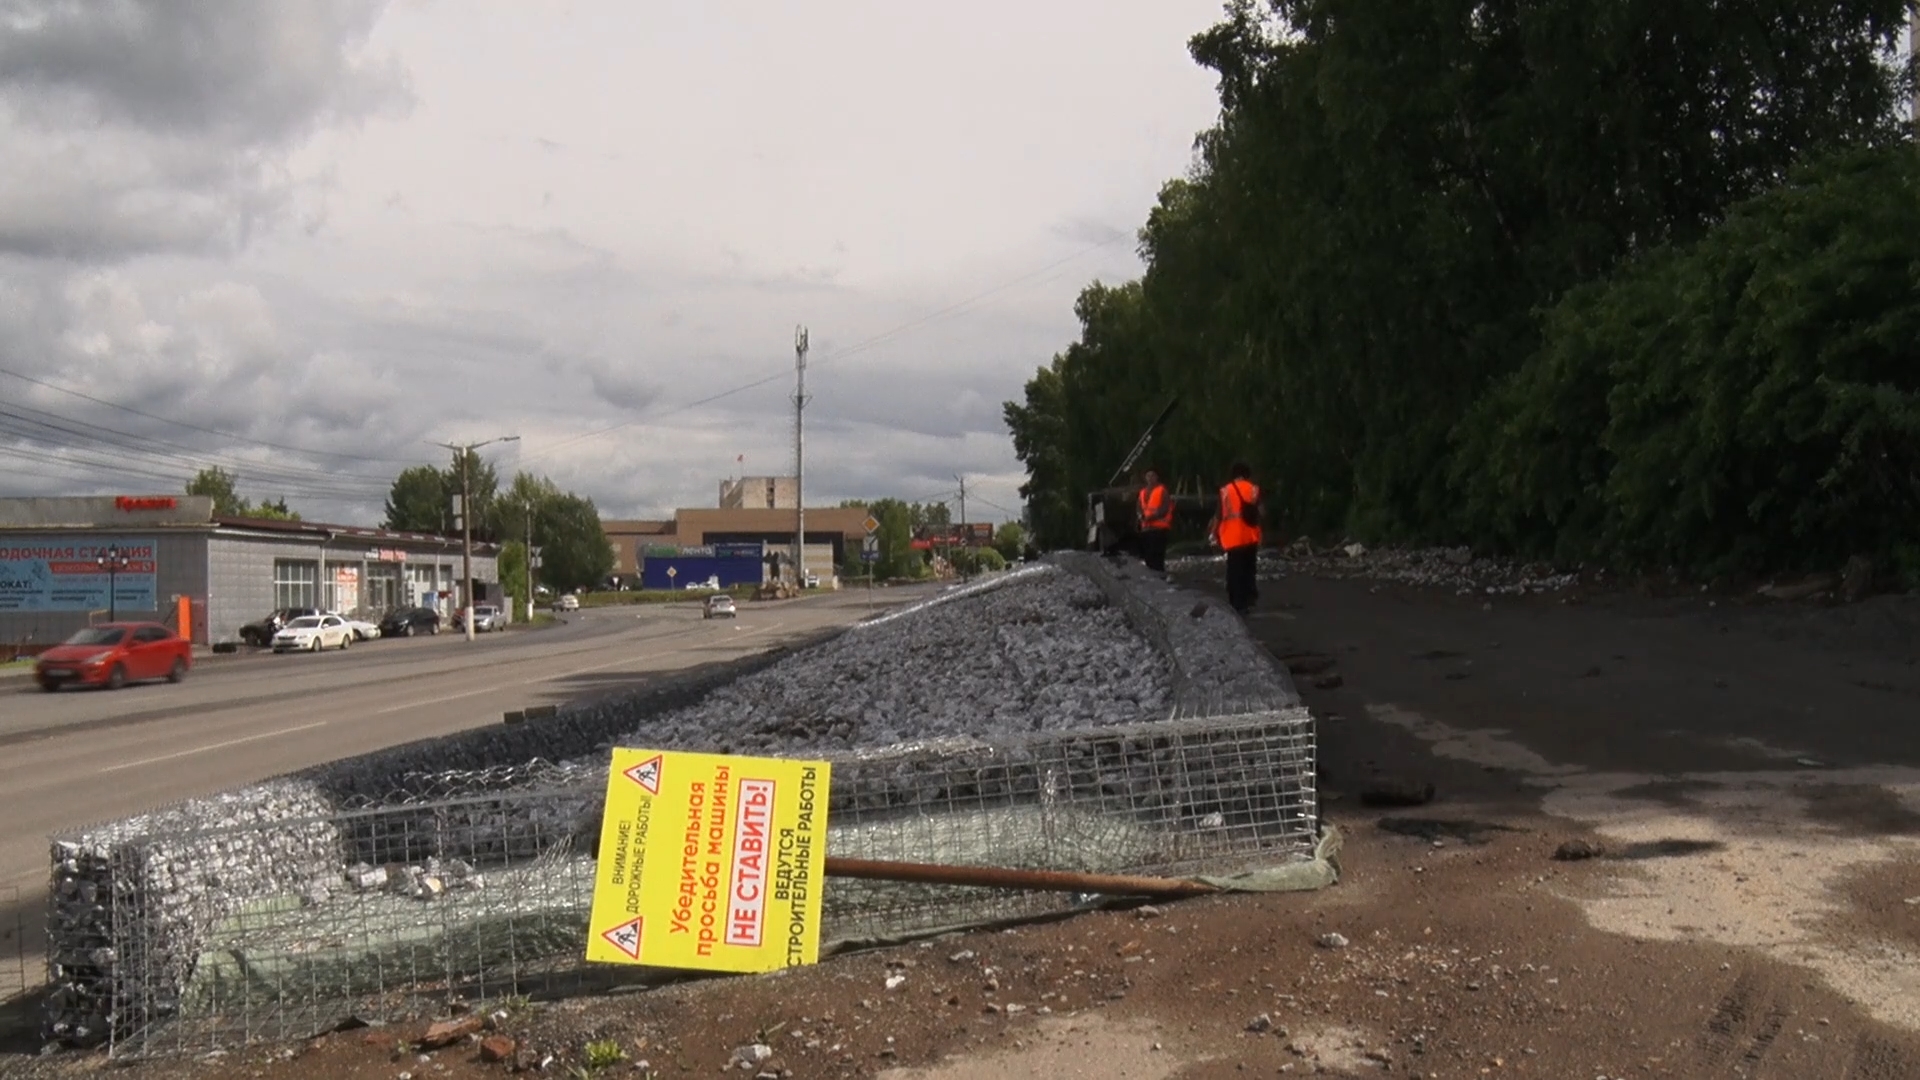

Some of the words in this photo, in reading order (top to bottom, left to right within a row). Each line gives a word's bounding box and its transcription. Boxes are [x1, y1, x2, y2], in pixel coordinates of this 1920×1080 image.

[708, 765, 730, 855] машины
[737, 785, 768, 901] СТАВИТЬ!
[798, 767, 816, 831] РАБОТЫ
[612, 820, 631, 884] ВНИМАНИЕ!
[626, 846, 646, 914] ДОРОЖНЫЕ
[641, 795, 653, 845] РАБОТЫ!
[670, 782, 705, 934] Убедительная
[775, 828, 795, 900] ВЕДУТСЯ
[697, 862, 720, 956] просьба
[733, 909, 757, 940] НЕ
[787, 836, 811, 967] СТРОИТЕЛЬНЫЕ
